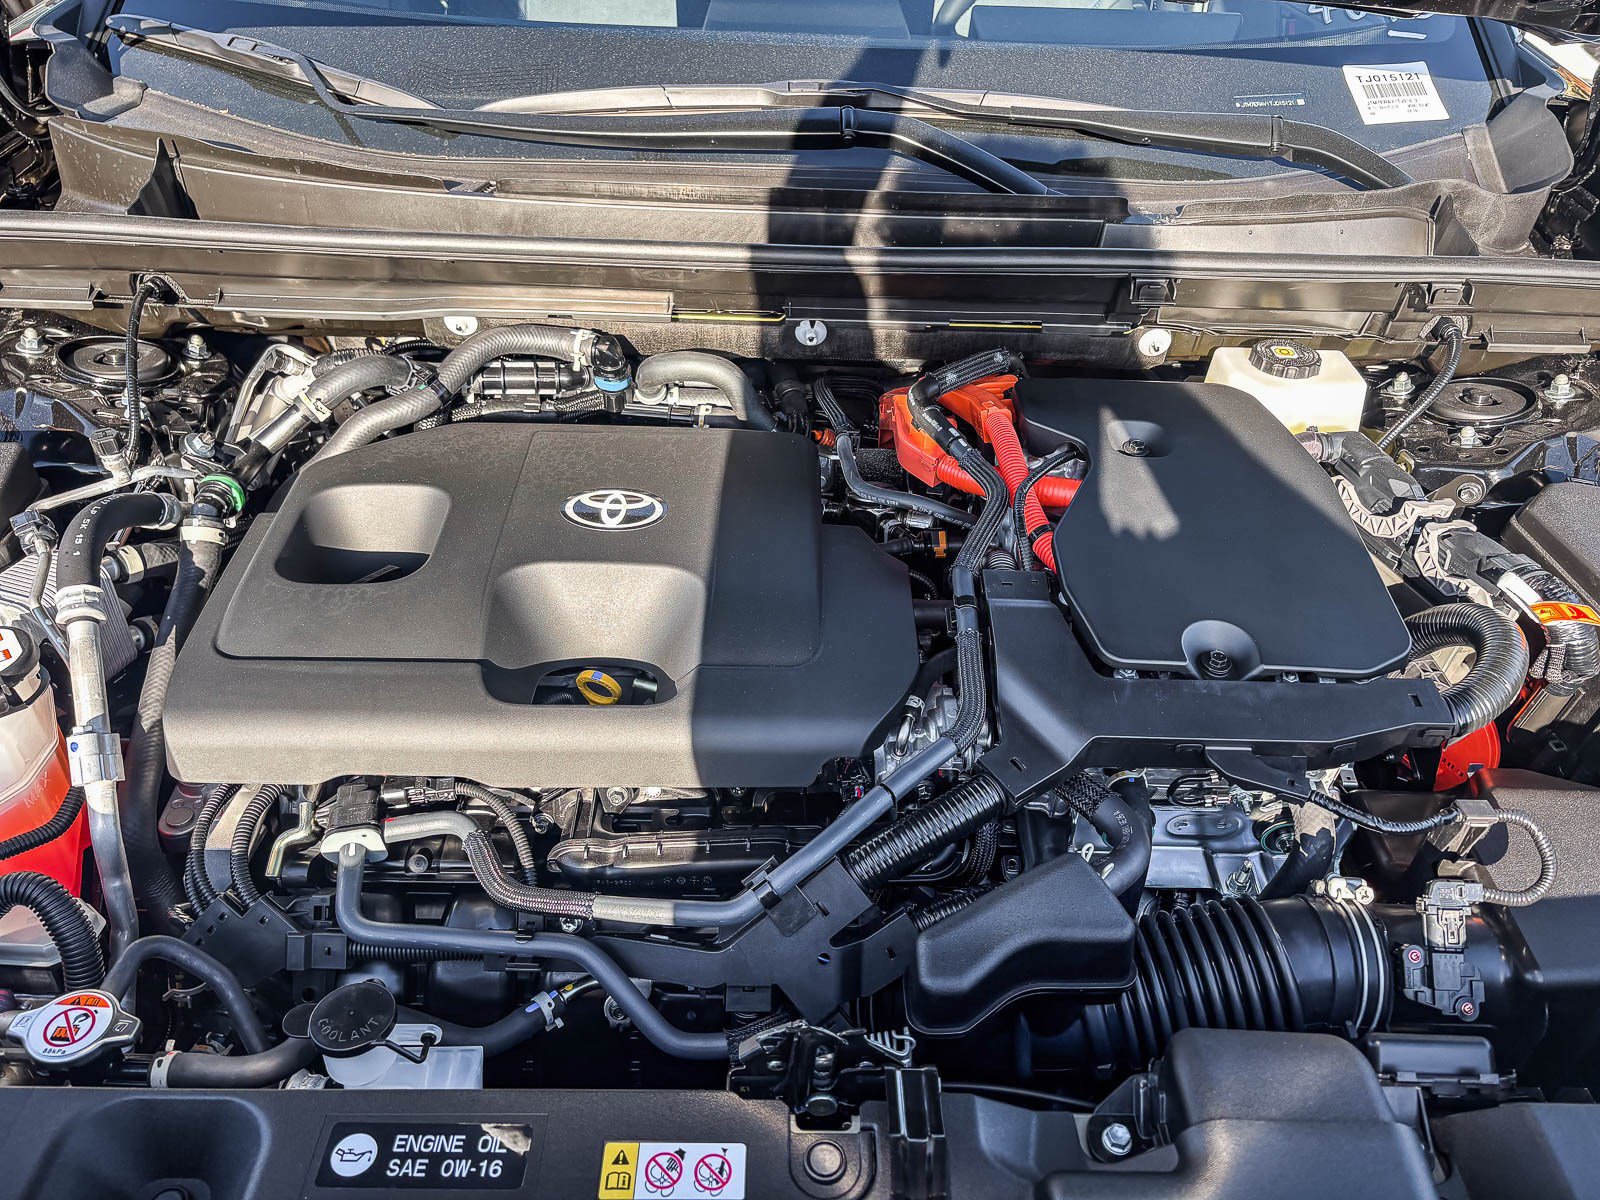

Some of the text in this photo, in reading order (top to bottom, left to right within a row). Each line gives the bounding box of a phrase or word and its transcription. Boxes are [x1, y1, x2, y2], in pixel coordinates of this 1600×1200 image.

[1355, 72, 1420, 83] TJ015121
[317, 1017, 379, 1042] COOLANT
[392, 1134, 508, 1153] ENGINE OIL
[386, 1159, 429, 1177] SAE
